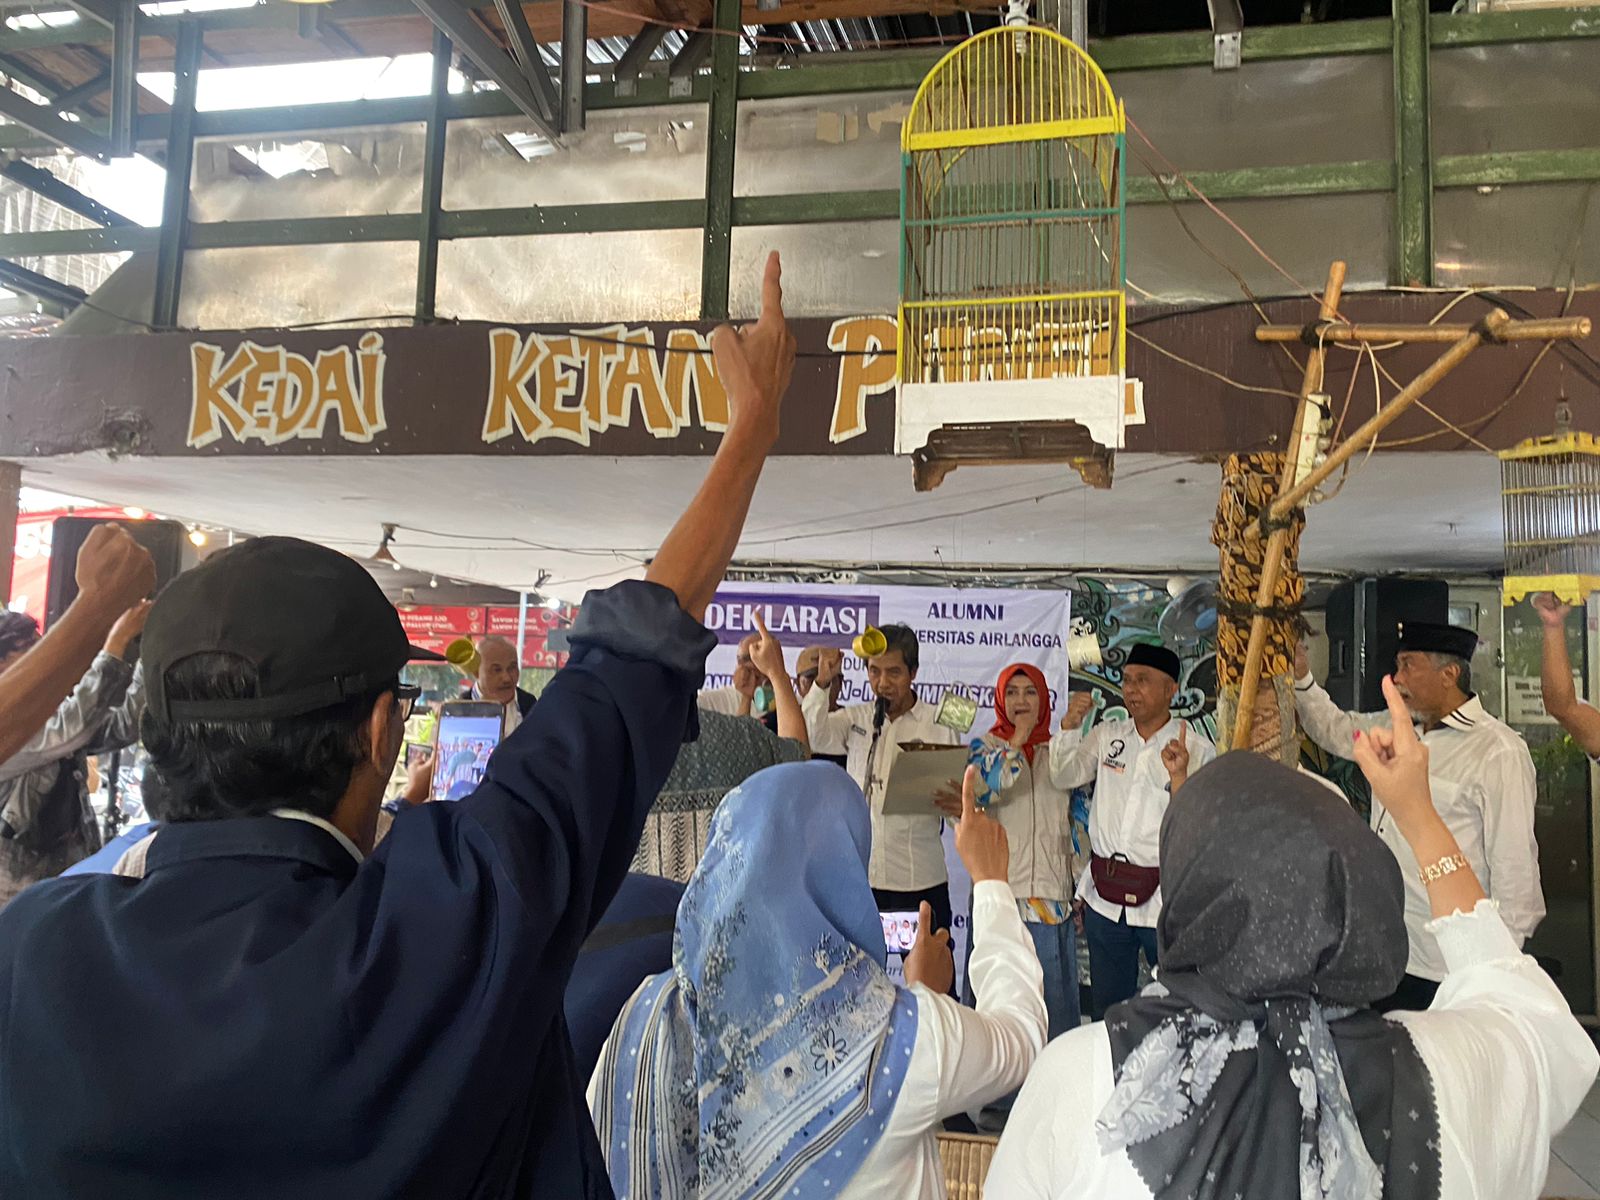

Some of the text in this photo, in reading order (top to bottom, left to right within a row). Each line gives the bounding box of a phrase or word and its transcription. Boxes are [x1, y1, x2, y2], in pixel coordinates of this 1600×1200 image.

[704, 603, 867, 635] DEKLARASI
[927, 602, 1004, 621] ALUMNI
[914, 629, 1062, 649] ERSITAS AIRLANGGA
